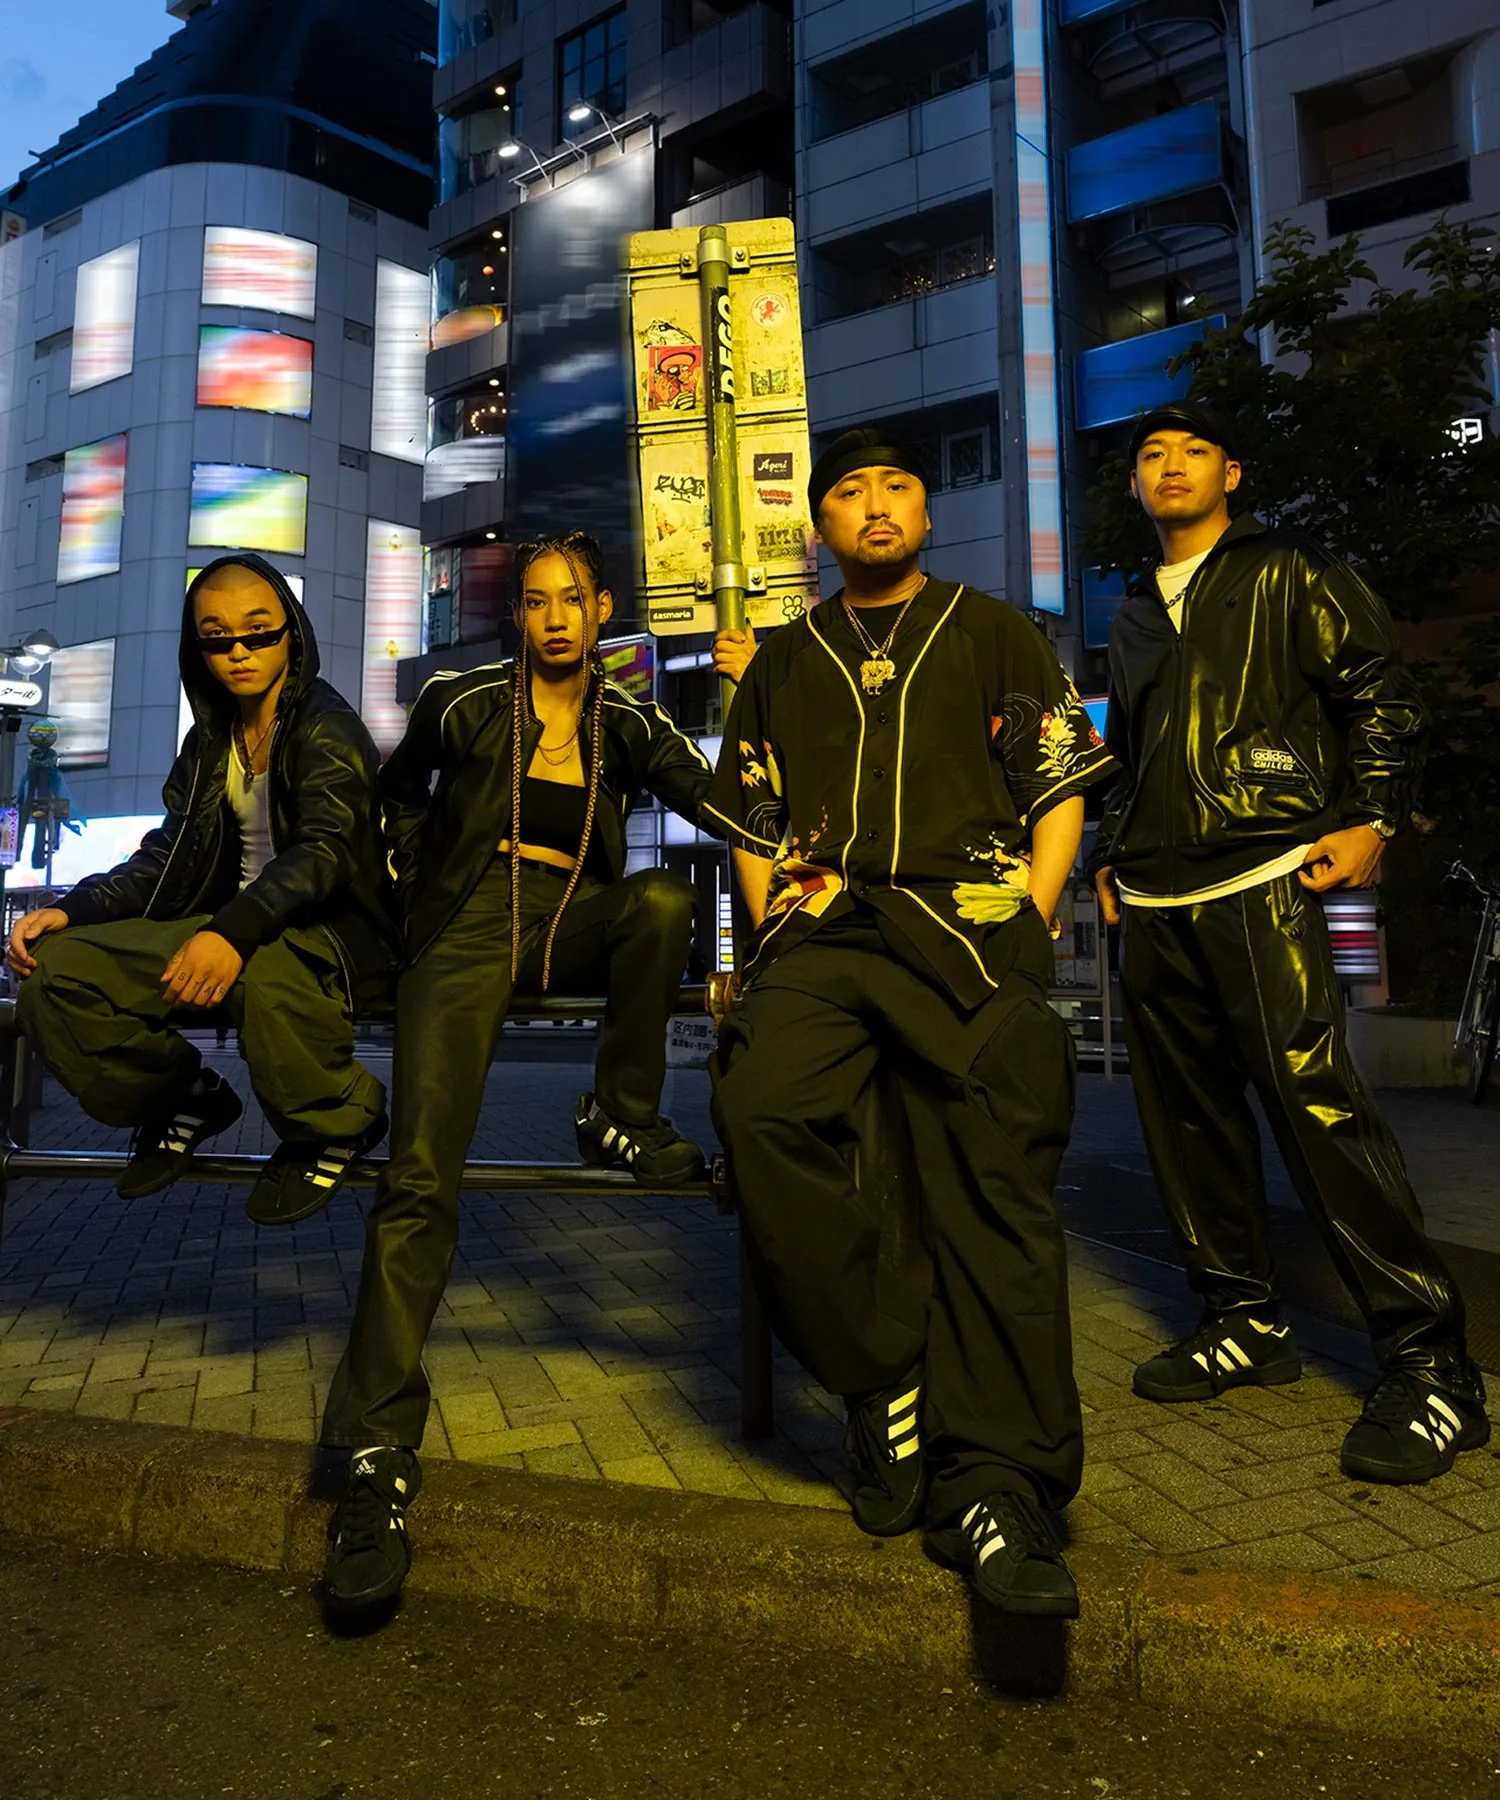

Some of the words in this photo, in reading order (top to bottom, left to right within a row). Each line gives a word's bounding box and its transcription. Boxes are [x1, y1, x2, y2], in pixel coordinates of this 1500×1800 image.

[1253, 750, 1295, 763] adidas
[1253, 760, 1282, 770] CHILE
[1282, 762, 1294, 771] 62
